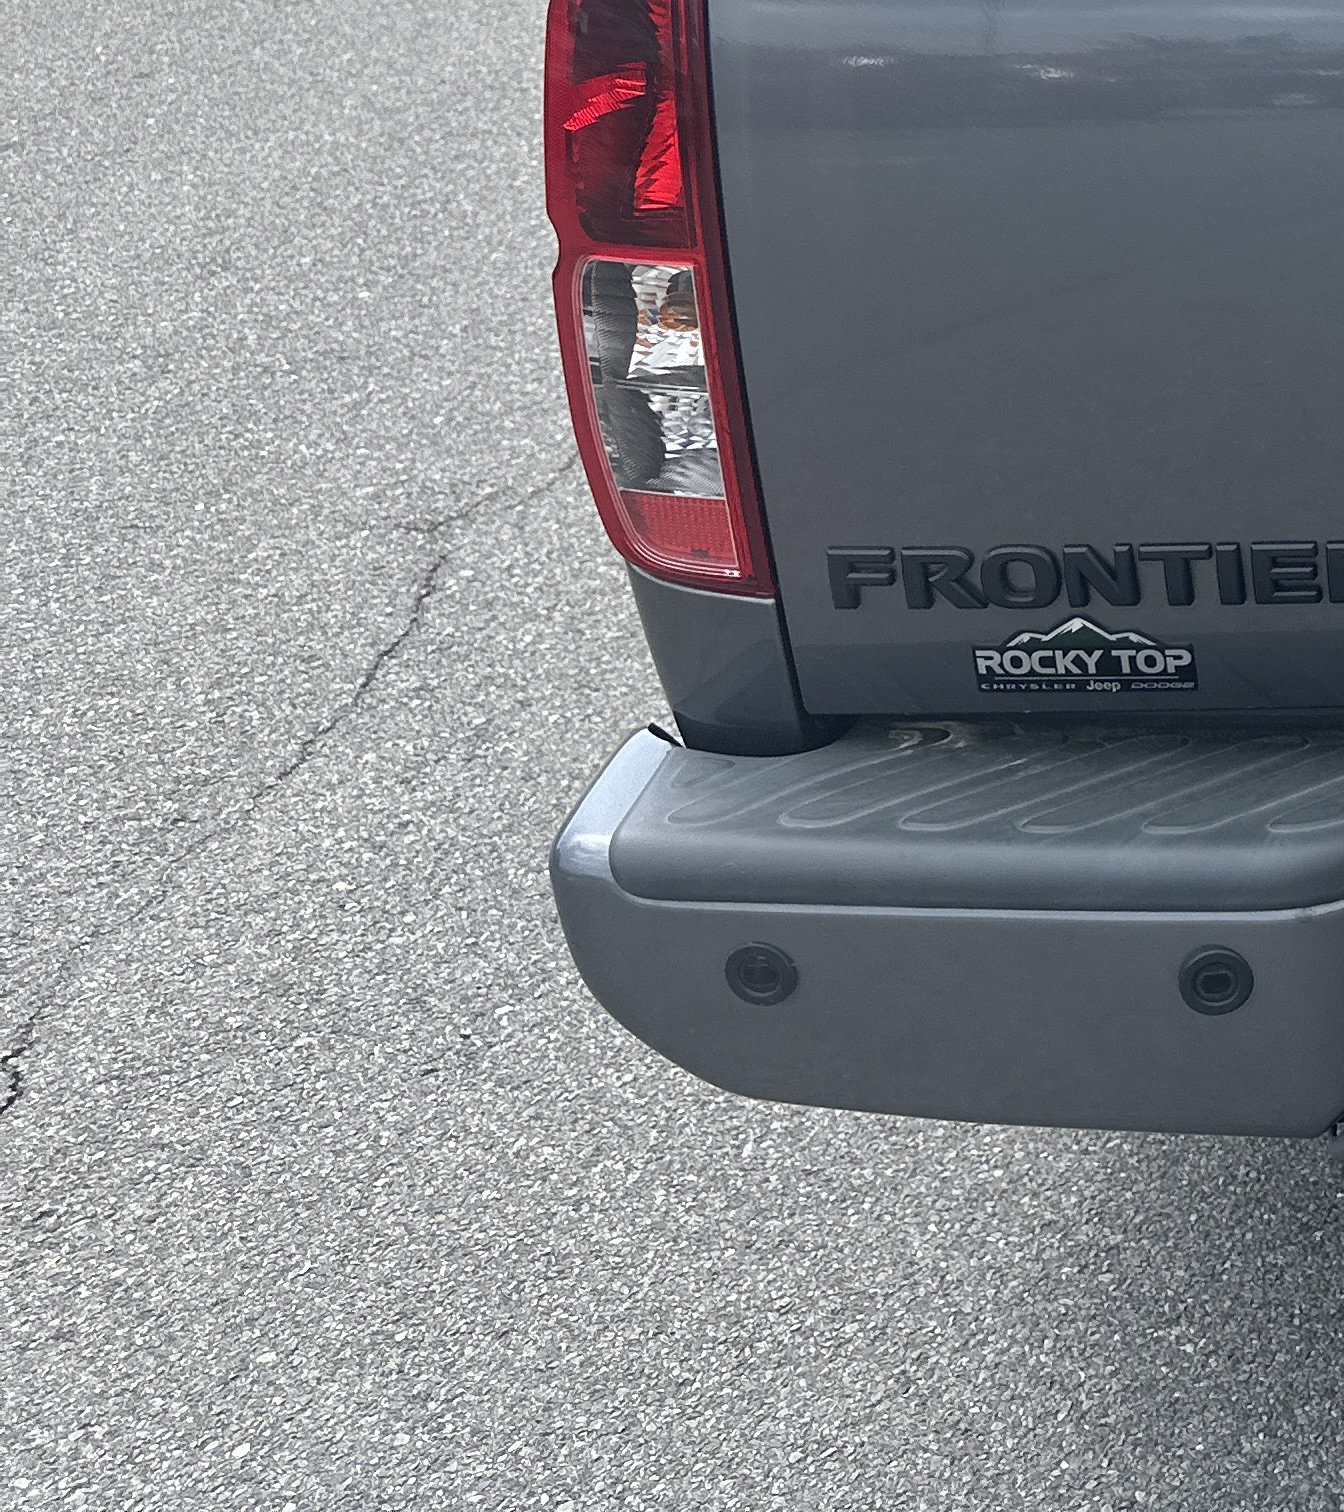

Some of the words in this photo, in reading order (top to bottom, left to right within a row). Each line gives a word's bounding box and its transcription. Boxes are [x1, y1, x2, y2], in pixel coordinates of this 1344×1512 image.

[975, 649, 1104, 675] ROCKY
[1111, 648, 1194, 675] TOP
[981, 683, 1077, 691] CHRYSLER
[1086, 678, 1121, 692] Jeep
[1131, 681, 1195, 690] DODGE
